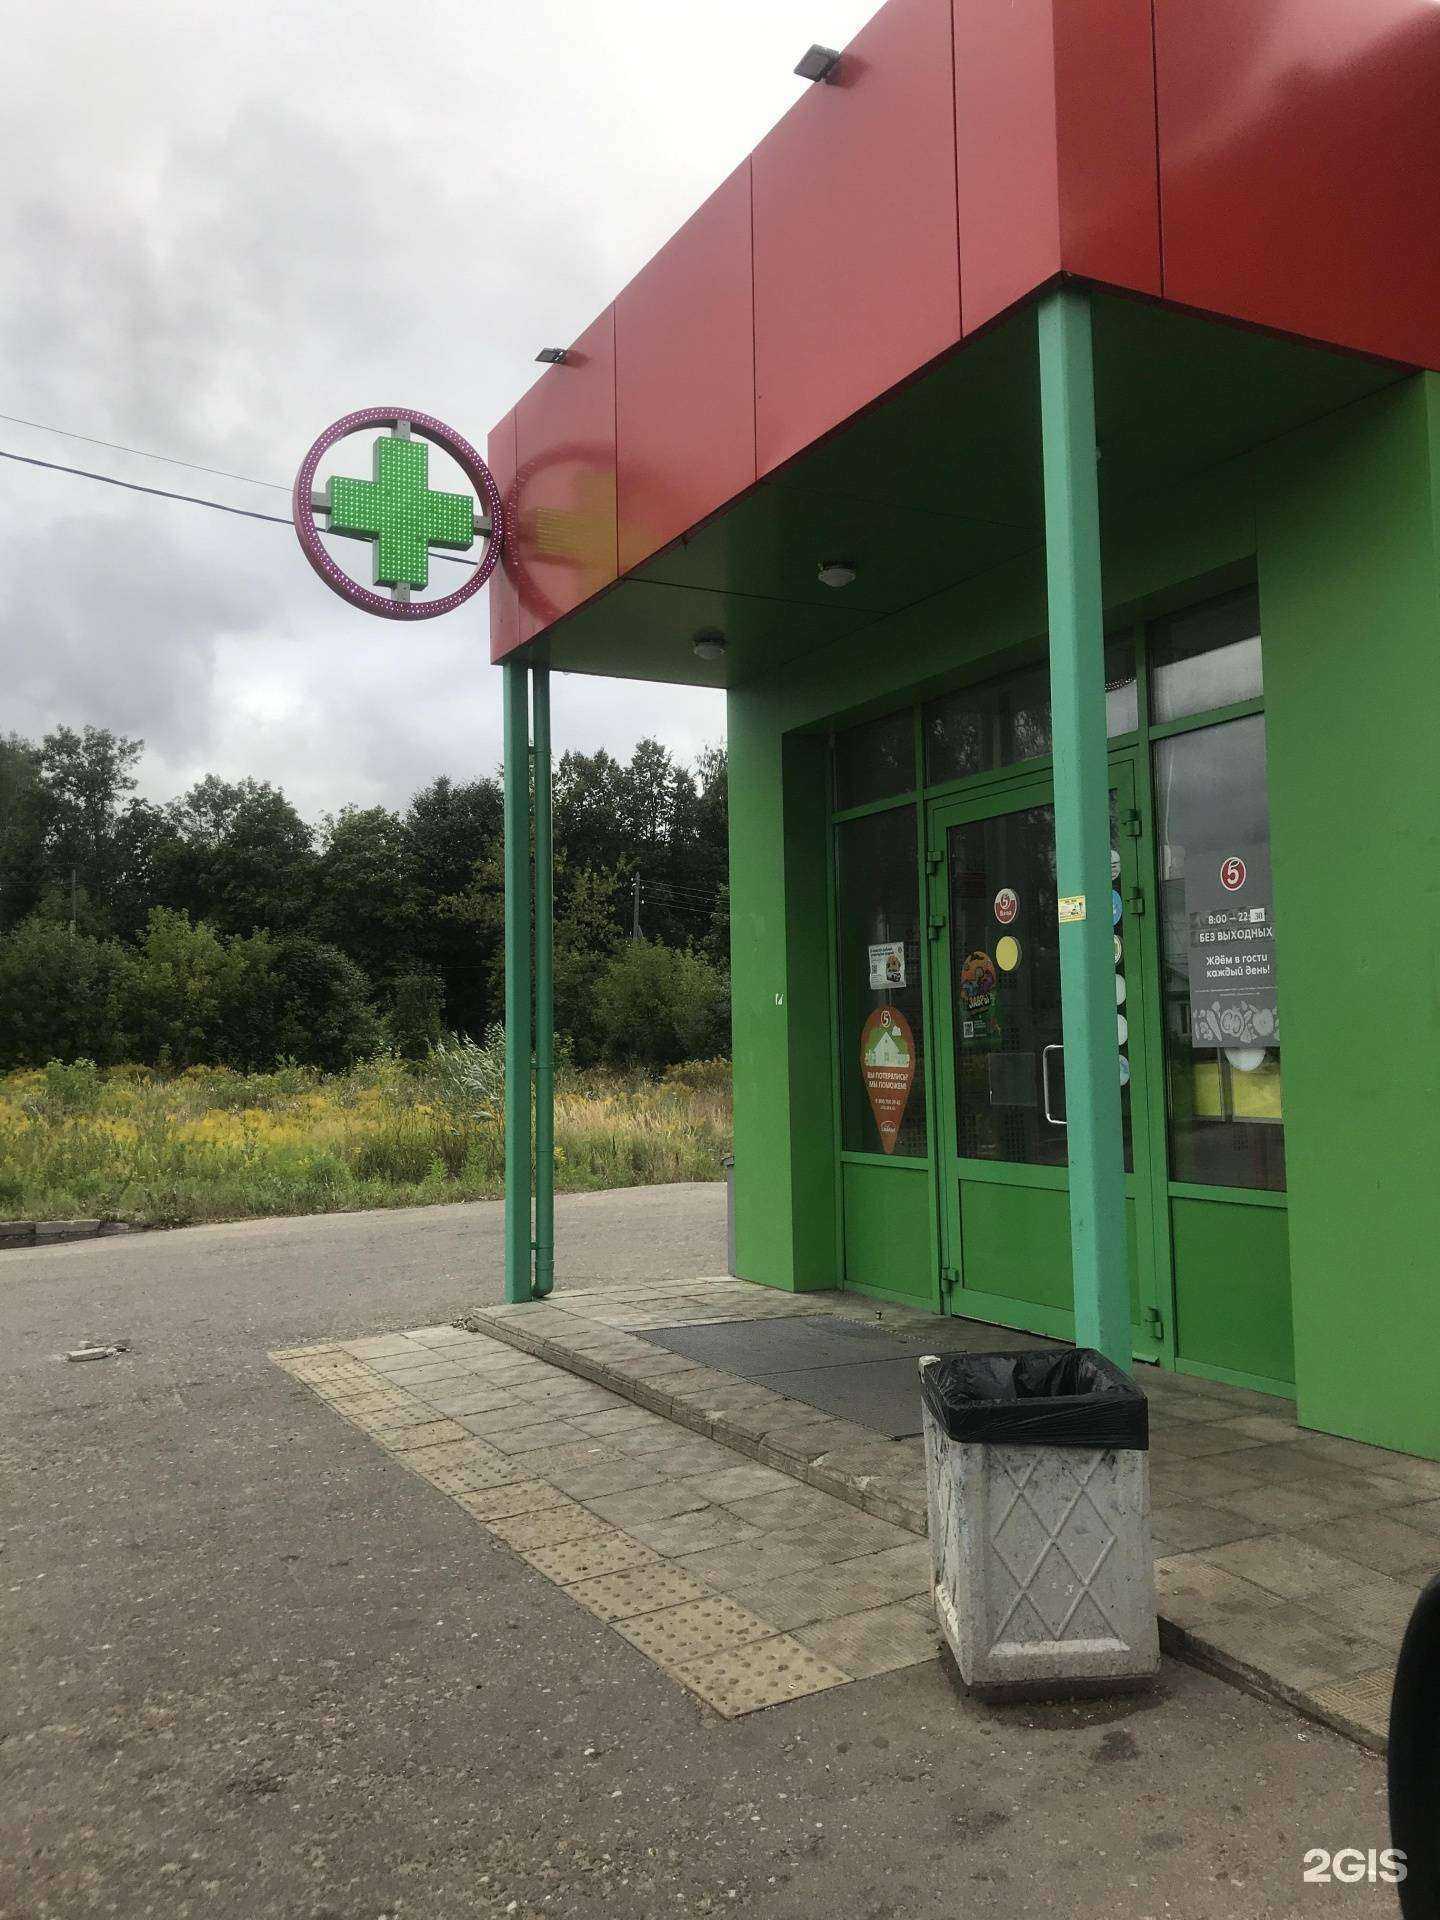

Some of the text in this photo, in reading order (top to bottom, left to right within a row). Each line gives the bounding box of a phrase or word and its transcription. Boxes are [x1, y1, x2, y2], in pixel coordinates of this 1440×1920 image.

[1208, 914, 1227, 924] 8:00
[1200, 927, 1273, 942] БЕЗ ВЫХОДНЫХ
[1206, 953, 1268, 966] Ждём в гости
[1206, 965, 1271, 978] каждый день!
